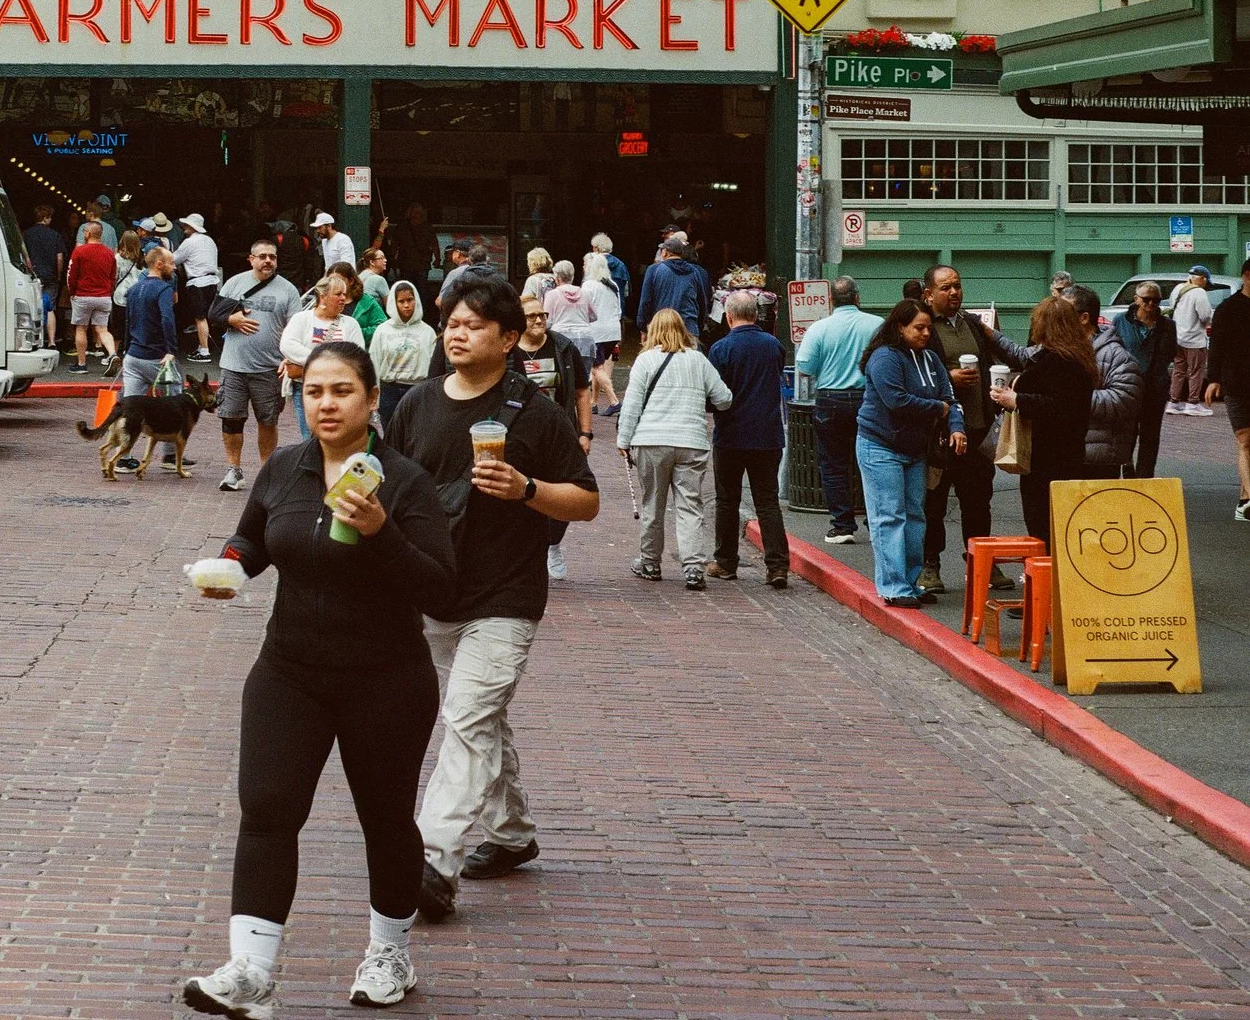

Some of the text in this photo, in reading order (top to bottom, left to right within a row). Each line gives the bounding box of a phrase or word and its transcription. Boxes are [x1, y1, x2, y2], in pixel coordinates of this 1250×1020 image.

[835, 59, 882, 83] Pike
[830, 106, 908, 117] Pike Place Market
[32, 133, 128, 147] VIWPOINT
[791, 284, 803, 293] NO
[795, 295, 826, 307] STOPS
[1071, 616, 1187, 628] 100% COLD PRESSED
[1086, 631, 1174, 641] ORGANIC JUICE
